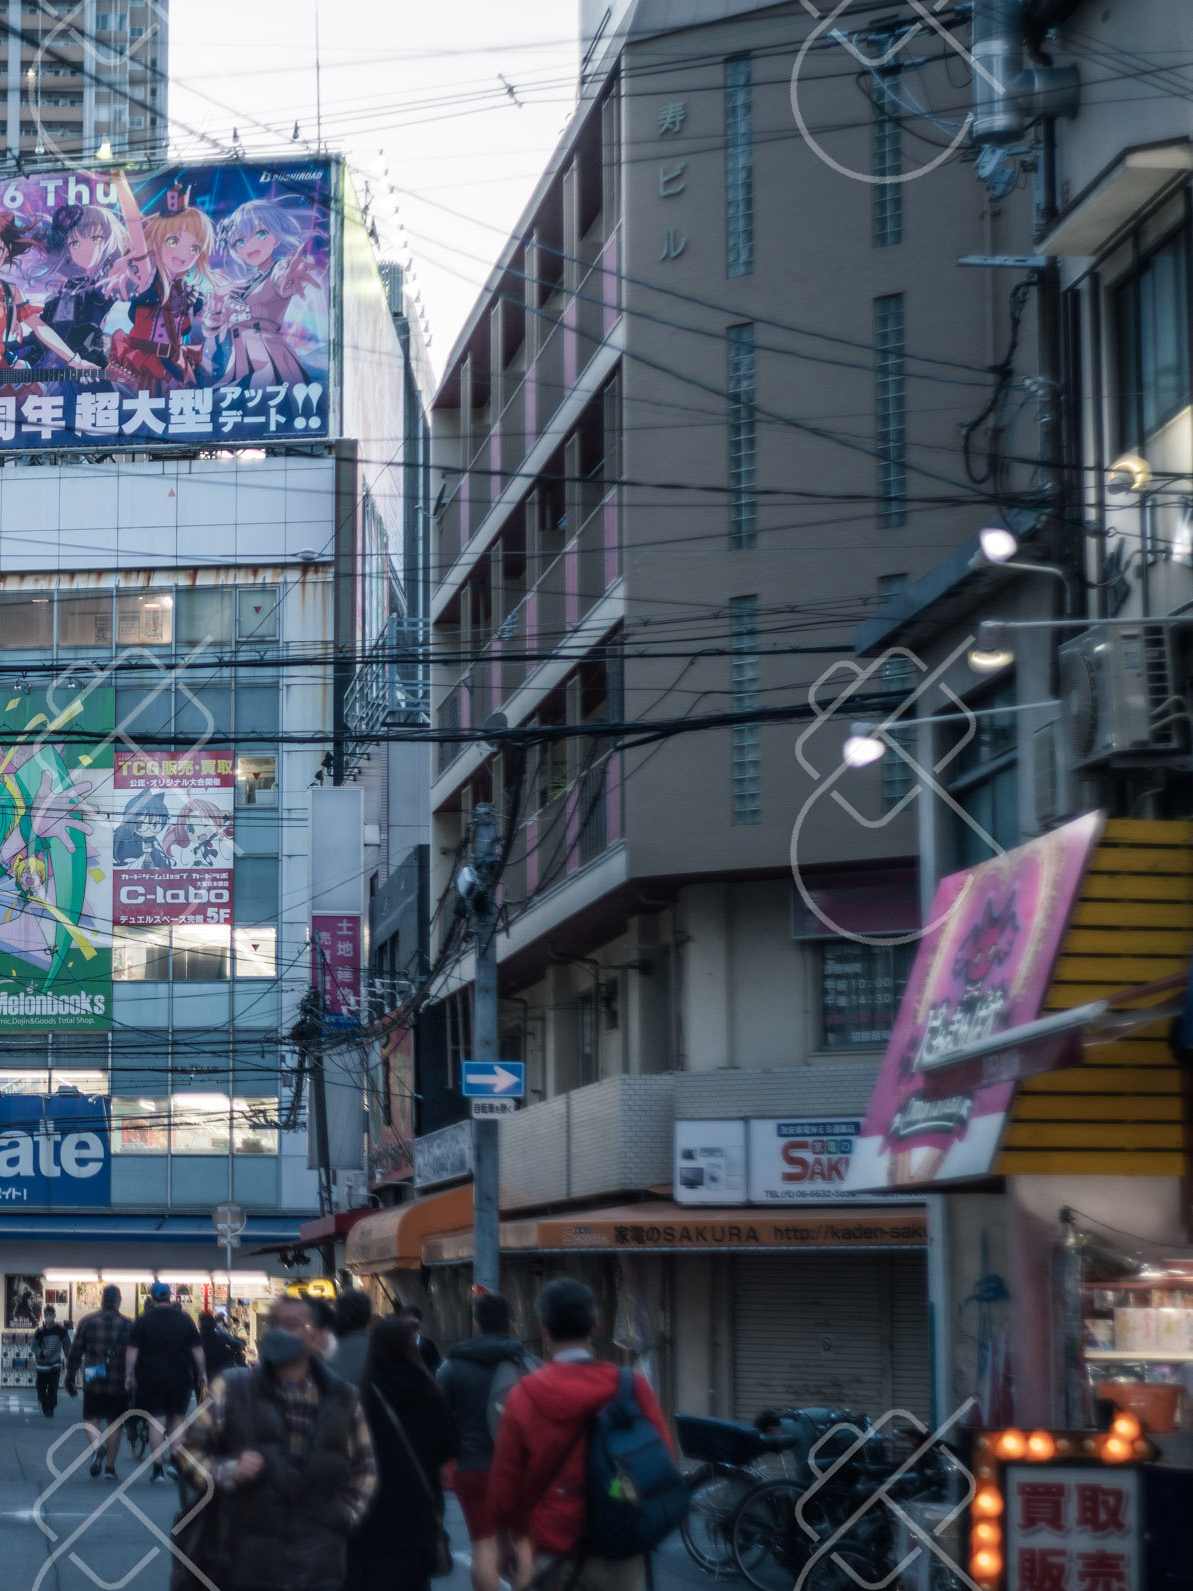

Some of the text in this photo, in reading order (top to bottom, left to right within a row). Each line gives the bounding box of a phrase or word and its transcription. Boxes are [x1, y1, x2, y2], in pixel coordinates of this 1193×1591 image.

[39, 177, 118, 207] Thu
[658, 102, 687, 261] 寿ビル
[219, 383, 289, 408] アップ
[75, 388, 213, 437] 超大型
[219, 410, 287, 433] デート
[120, 885, 230, 904] C-labo
[207, 907, 231, 924] 5F
[1017, 1481, 1127, 1533] 買取
[1017, 1548, 1127, 1591] 販売
